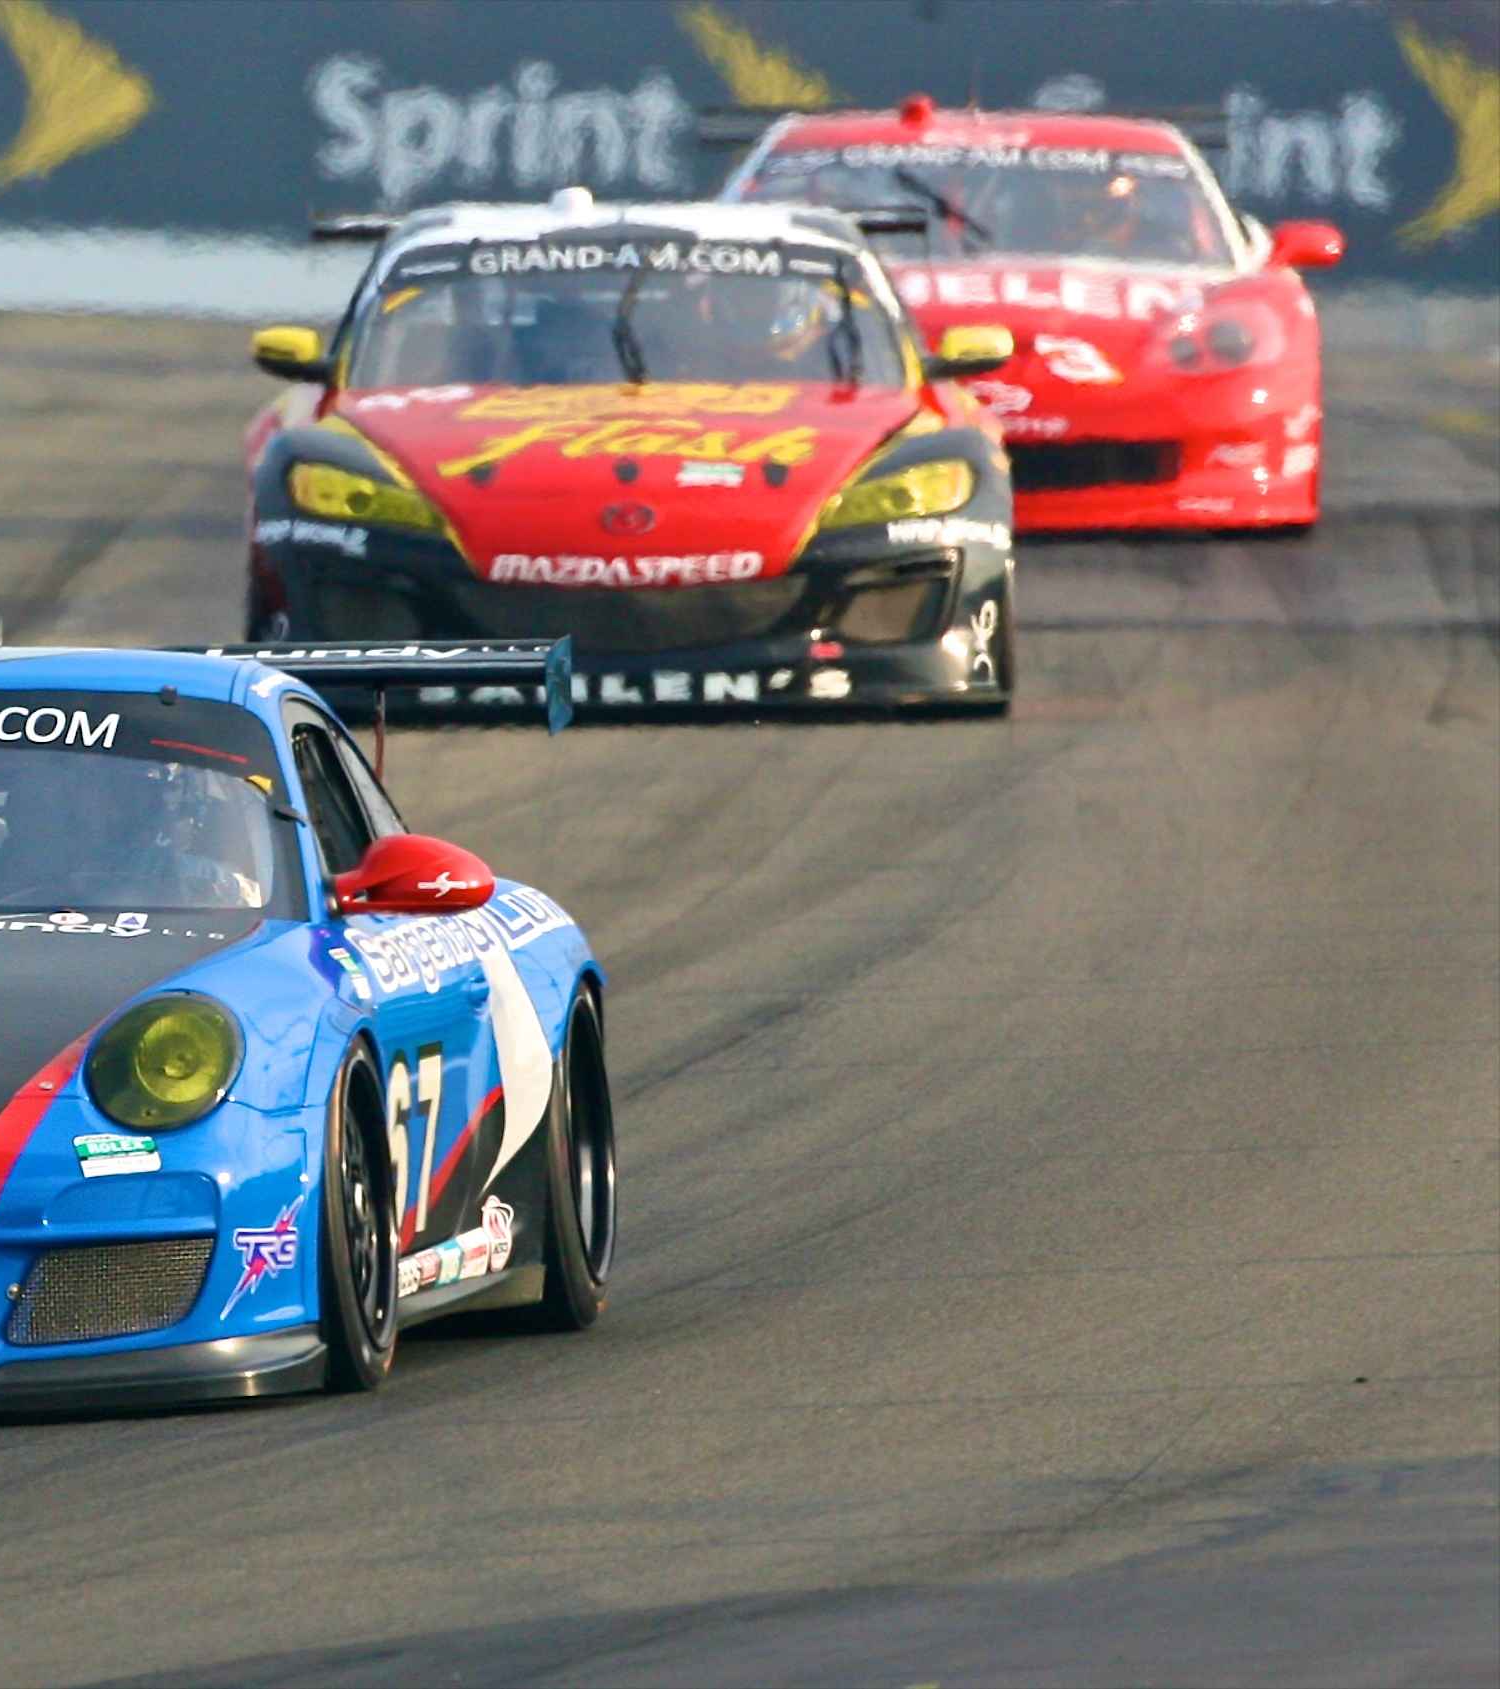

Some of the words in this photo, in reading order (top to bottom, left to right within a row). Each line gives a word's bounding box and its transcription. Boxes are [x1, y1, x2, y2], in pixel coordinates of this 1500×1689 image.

[310, 52, 692, 202] Sprint
[470, 243, 783, 276] GRAND-AM.COM
[490, 550, 763, 586] MAZDASPEED
[386, 1040, 443, 1234] 67
